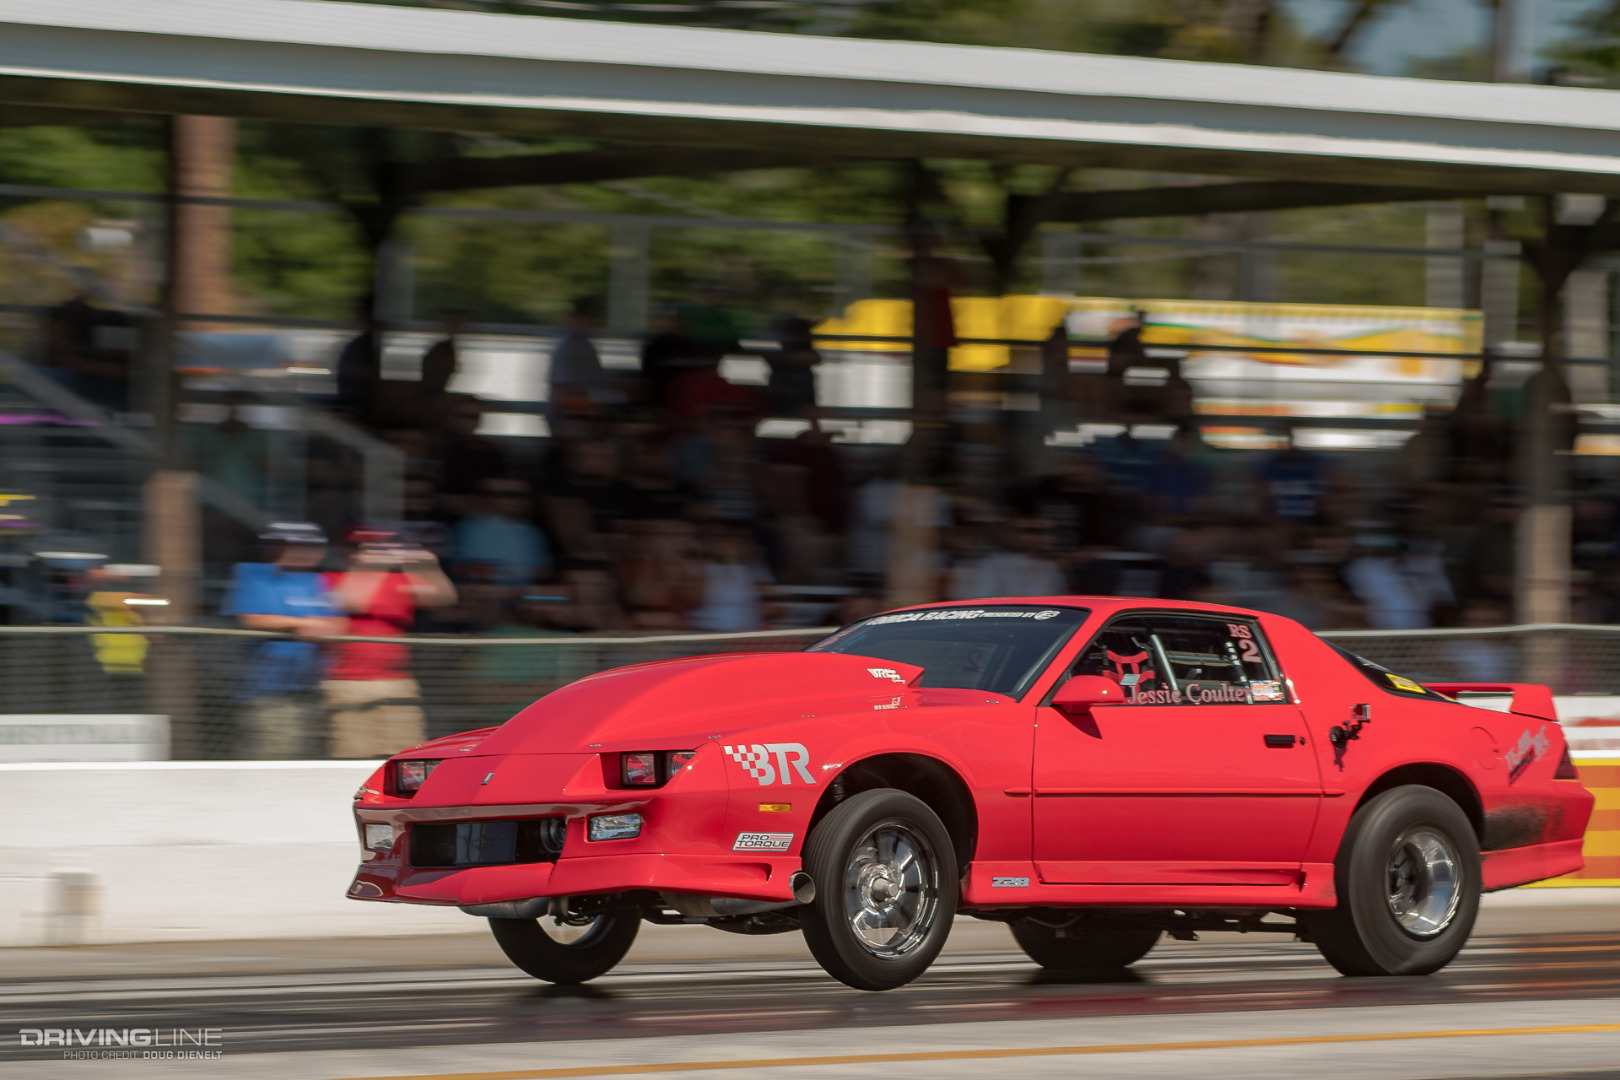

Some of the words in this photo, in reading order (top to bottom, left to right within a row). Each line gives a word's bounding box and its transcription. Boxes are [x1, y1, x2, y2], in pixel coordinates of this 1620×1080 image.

[919, 610, 985, 621] RACING
[1226, 623, 1253, 639] RS
[1238, 639, 1263, 663] 2
[1127, 684, 1182, 705] Jessie
[1185, 683, 1251, 703] Coulter
[748, 742, 816, 786] BTR
[738, 840, 790, 848] TORQUE
[991, 876, 1030, 888] Z28
